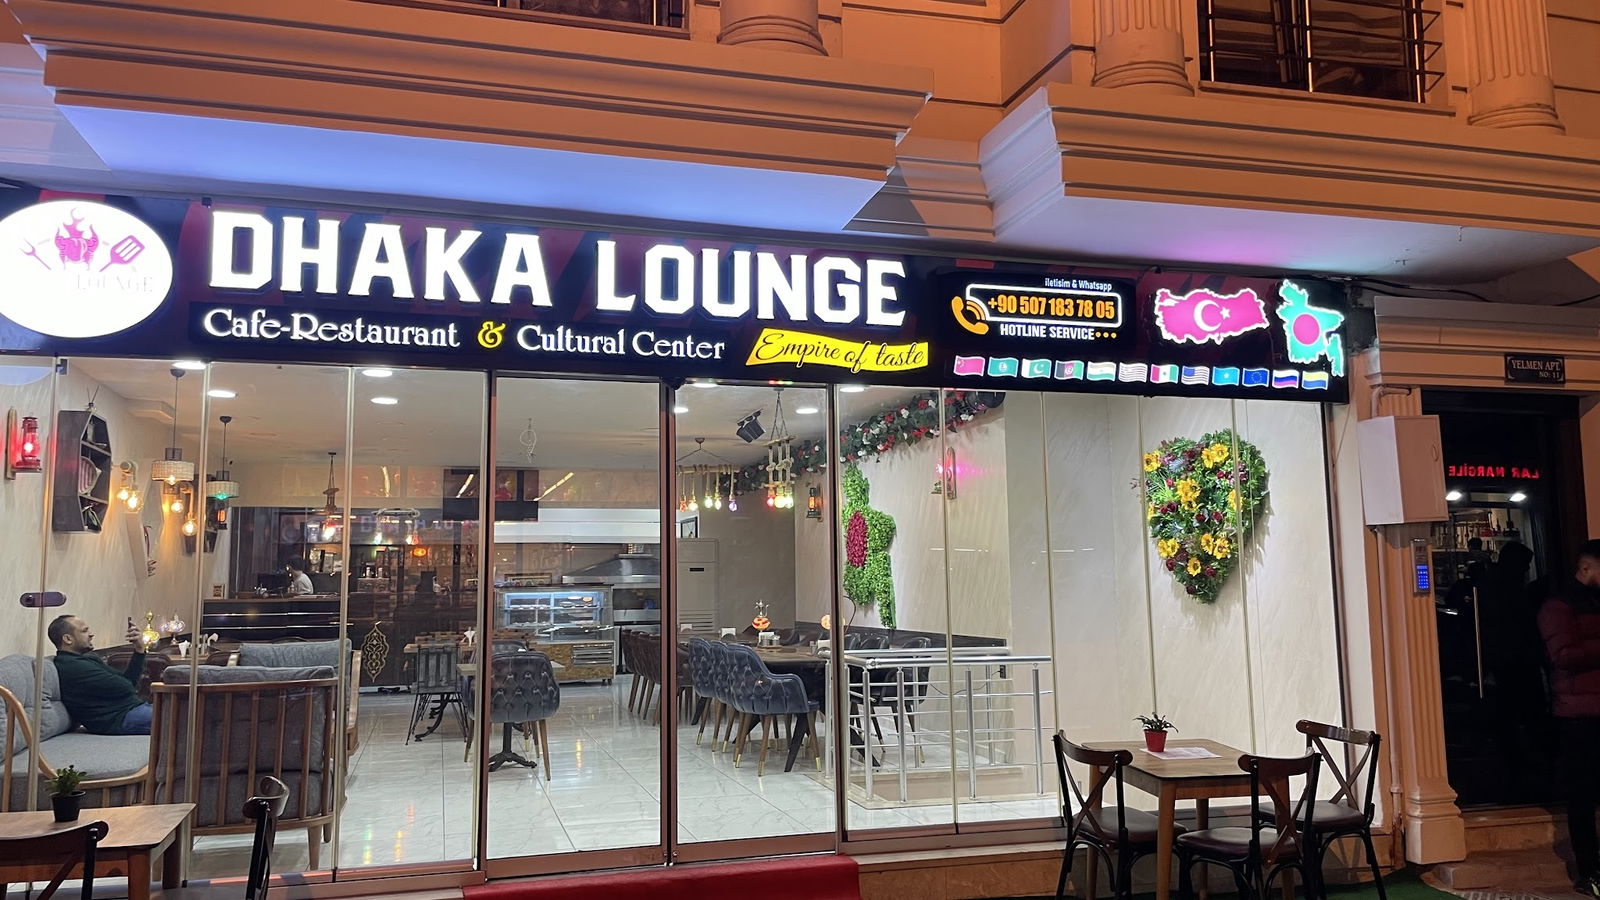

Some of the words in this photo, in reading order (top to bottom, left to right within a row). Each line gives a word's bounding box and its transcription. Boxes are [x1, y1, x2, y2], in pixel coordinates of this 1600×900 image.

[209, 211, 553, 307] DHAKA
[595, 239, 907, 327] LOUNGE
[1072, 279, 1078, 289] &
[1078, 280, 1112, 292] Whatsapp
[988, 295, 1017, 314] +90
[1019, 296, 1046, 315] 507
[1048, 298, 1074, 317] 183
[1076, 299, 1093, 318] 78
[1095, 301, 1115, 319] 05
[203, 308, 461, 348] Cafe-Restaurant
[478, 320, 505, 348] &
[516, 324, 626, 356] Cultural
[632, 330, 726, 360] Center
[1000, 323, 1047, 338] HOTLINE
[755, 332, 841, 368] Empire
[843, 341, 872, 374] of
[875, 341, 926, 367] taste
[1511, 359, 1543, 370] YELMEN
